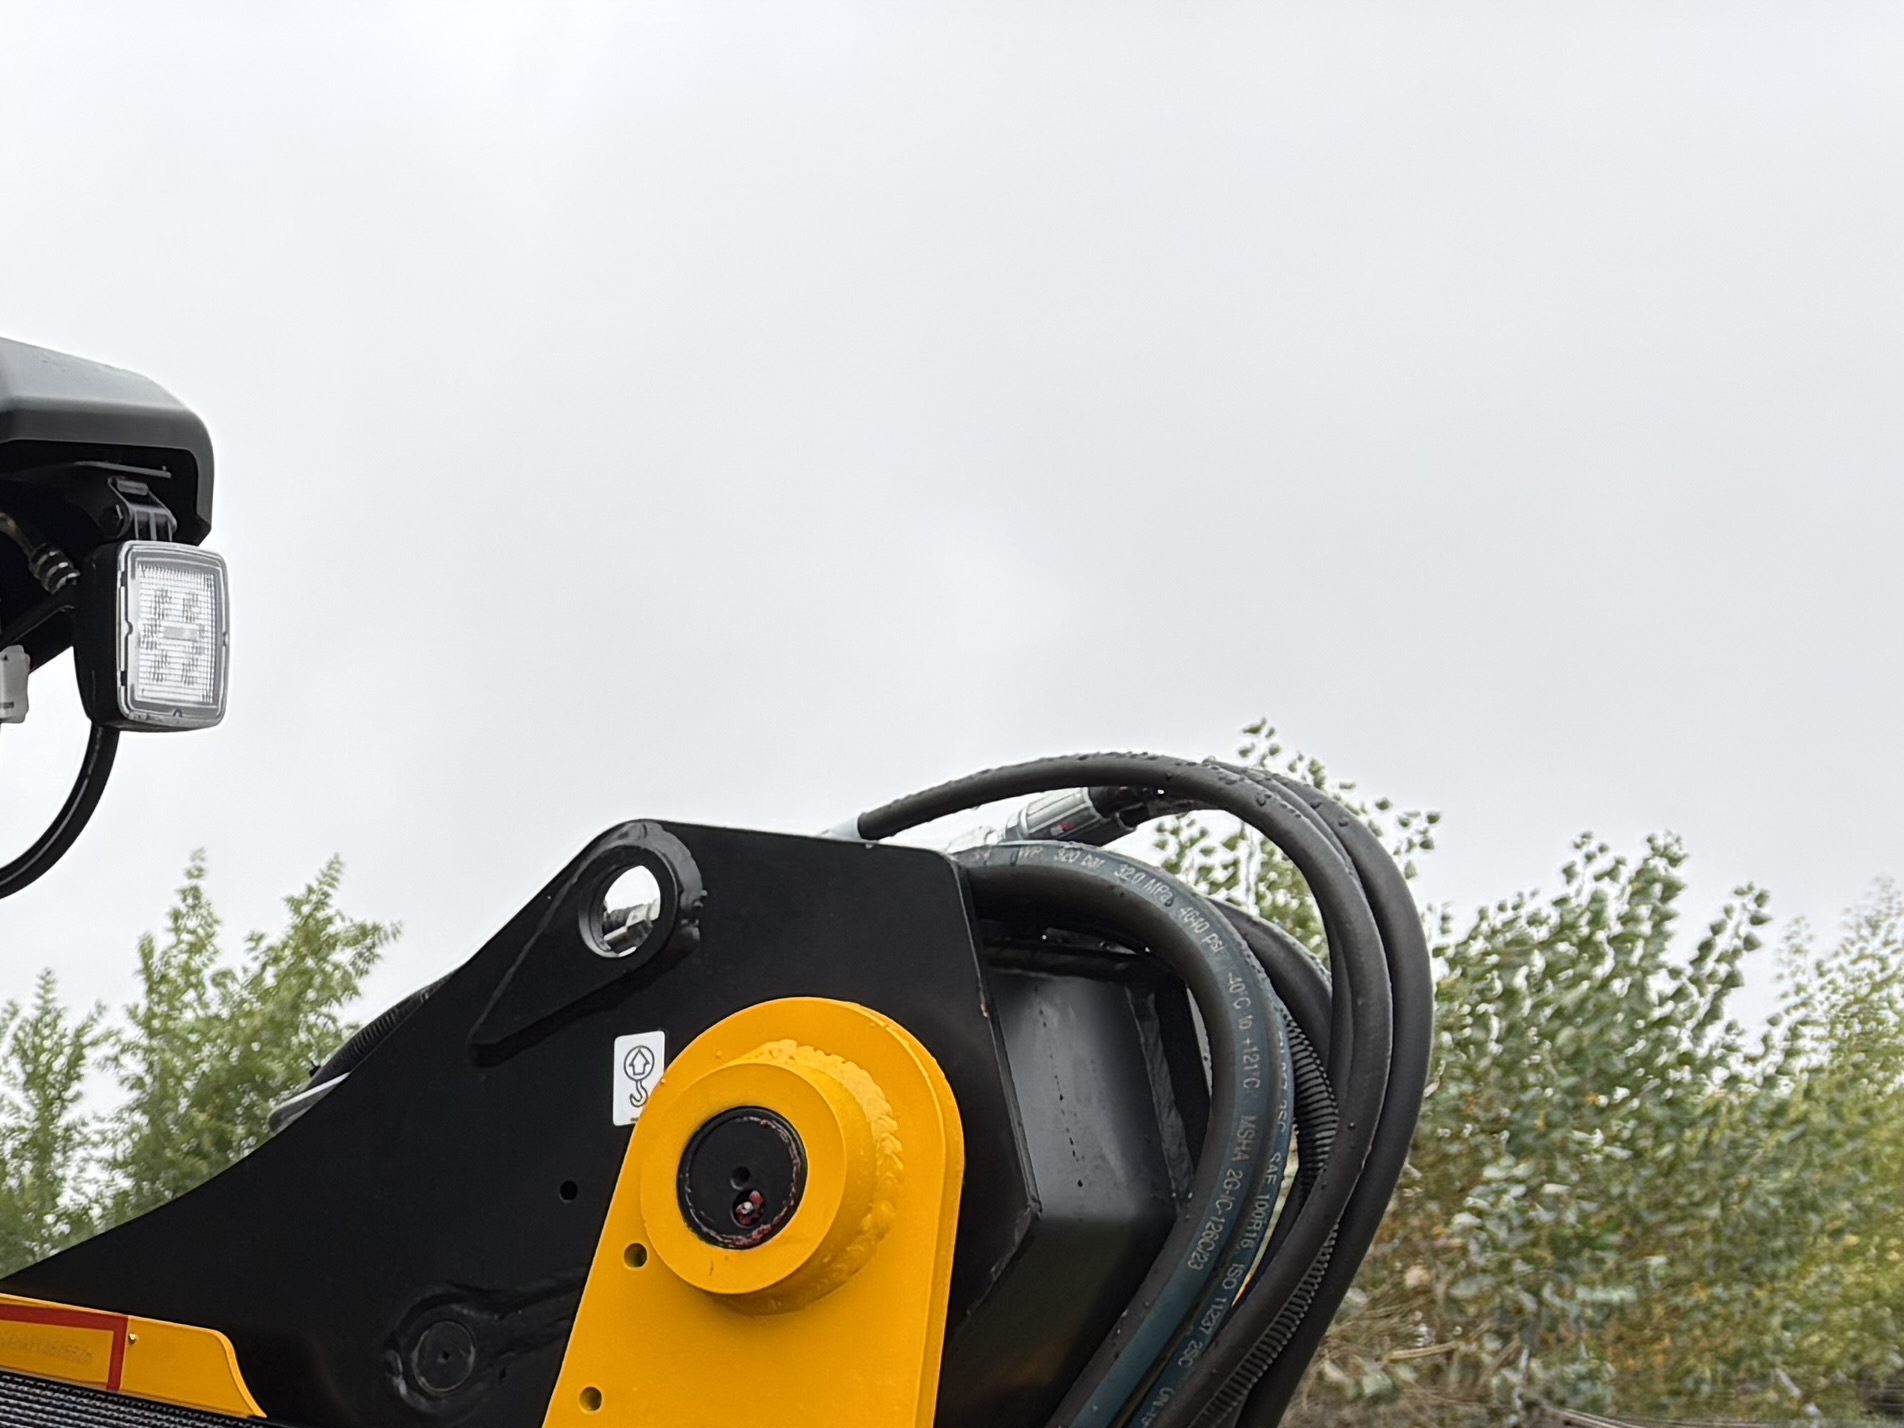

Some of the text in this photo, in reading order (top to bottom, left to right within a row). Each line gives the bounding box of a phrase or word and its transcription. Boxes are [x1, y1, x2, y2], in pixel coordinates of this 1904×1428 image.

[1201, 931, 1225, 953] psi
[1238, 1015, 1253, 1029] to
[1233, 1115, 1256, 1162] MSHA
[1222, 1264, 1246, 1289] ISO
